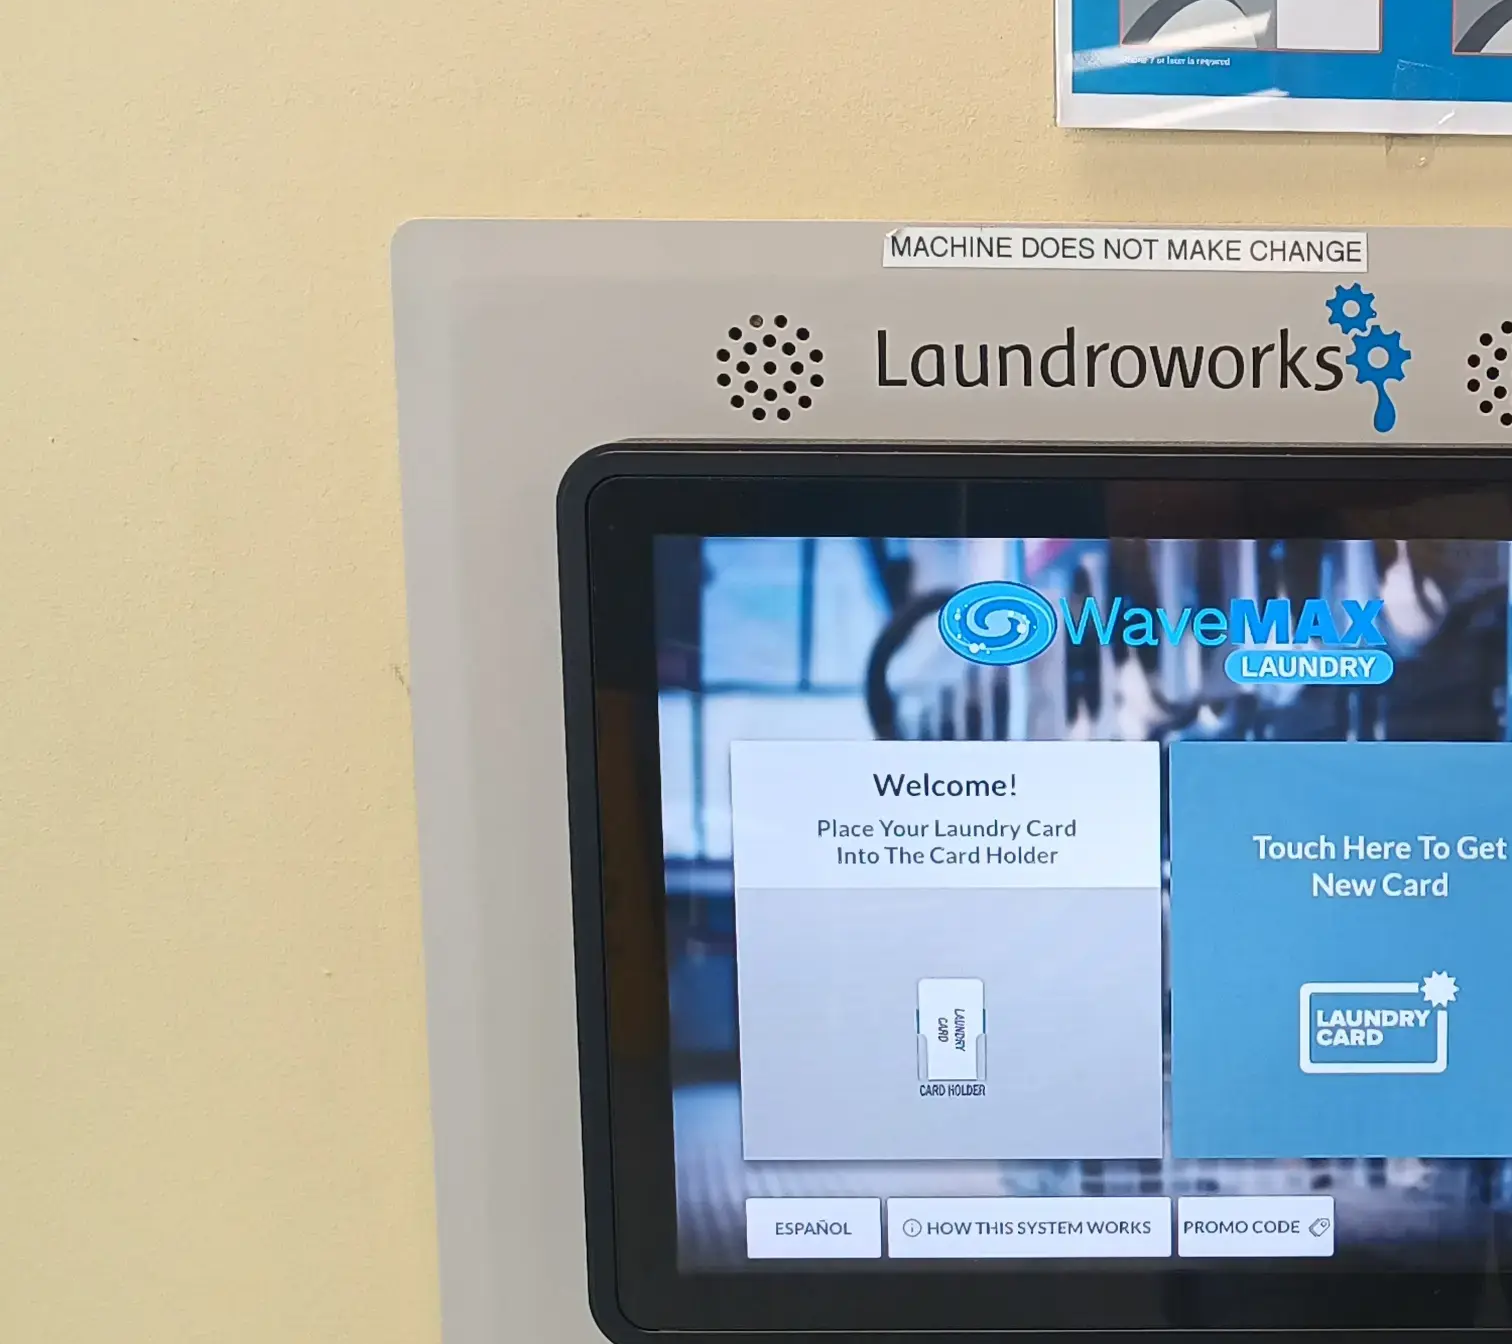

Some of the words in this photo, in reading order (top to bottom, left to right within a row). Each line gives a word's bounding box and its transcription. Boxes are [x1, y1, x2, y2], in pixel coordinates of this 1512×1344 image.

[890, 235, 1013, 260] MACHINE
[1021, 236, 1096, 261] DOES
[1103, 236, 1159, 261] NOT
[1167, 238, 1242, 262] MAKE
[1249, 239, 1362, 264] CHANGE
[876, 326, 1344, 391] Laundroworks
[1058, 596, 1387, 647] WaveMAX
[1241, 655, 1377, 680] LAUNDRY
[872, 771, 1018, 799] Welcome!
[816, 819, 874, 839] Place
[880, 819, 929, 840] Your
[934, 819, 1021, 844] Laundry
[1026, 819, 1078, 840] Card
[836, 844, 878, 865] Into
[883, 844, 925, 865] The
[930, 844, 982, 865] Card
[987, 844, 1059, 866] Holder
[1252, 833, 1337, 862] Touch
[1343, 834, 1411, 862] Here
[1417, 834, 1450, 862] To
[1456, 834, 1508, 862] Get
[1311, 872, 1374, 898] New
[1382, 872, 1449, 898] Card
[938, 1017, 949, 1043] CARD
[954, 1008, 966, 1052] LAUNDRY
[1316, 1009, 1431, 1028] LAUNDRY
[1316, 1027, 1384, 1047] CARD
[919, 1084, 946, 1097] CARD
[948, 1084, 986, 1097] HOLDER
[774, 1216, 852, 1237] ESPAÑOL
[926, 1219, 972, 1237] HOW
[975, 1219, 1012, 1237] THIS
[1015, 1219, 1081, 1237] SYSTEM
[1084, 1218, 1152, 1237] WORKS
[1183, 1218, 1248, 1236] PROMO
[1252, 1218, 1301, 1236] CODE
